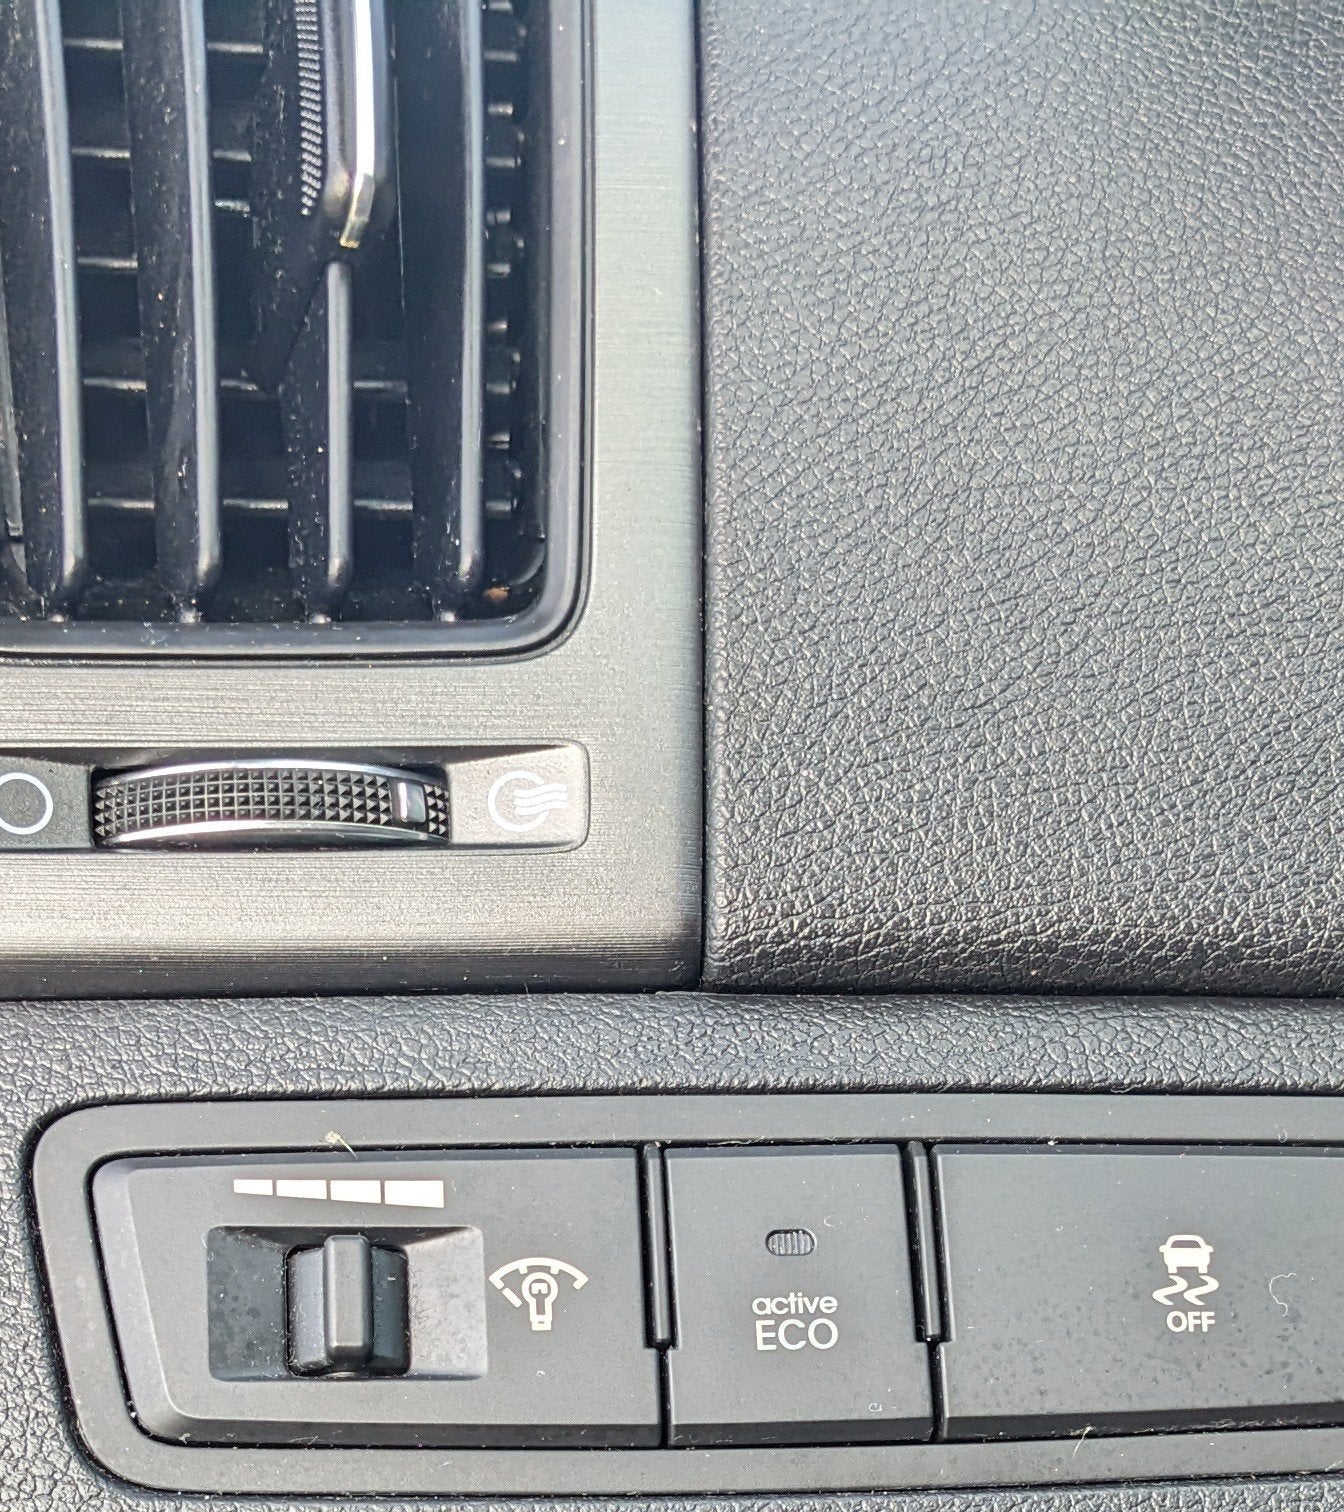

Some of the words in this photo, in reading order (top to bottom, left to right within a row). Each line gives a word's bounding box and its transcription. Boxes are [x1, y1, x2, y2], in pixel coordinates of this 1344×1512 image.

[751, 1291, 839, 1316] active
[1166, 1310, 1216, 1333] OFF
[755, 1318, 839, 1351] ECO
